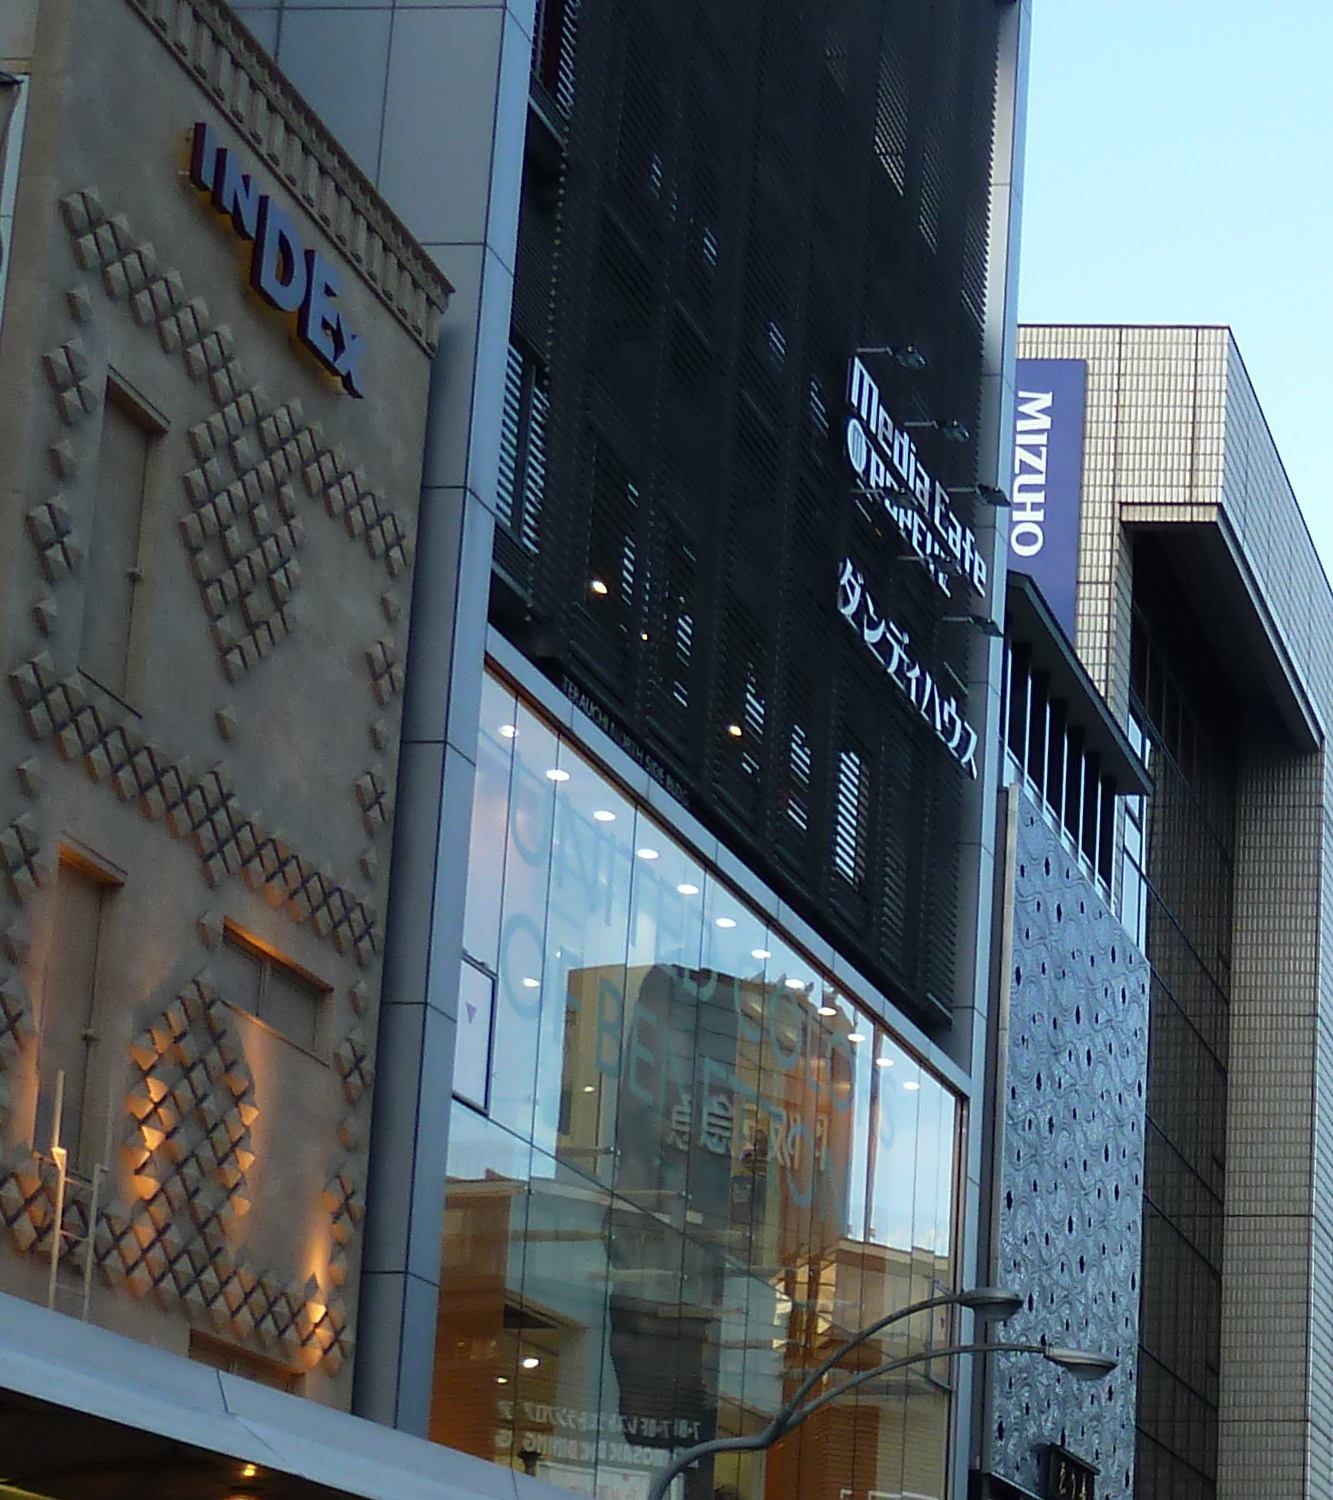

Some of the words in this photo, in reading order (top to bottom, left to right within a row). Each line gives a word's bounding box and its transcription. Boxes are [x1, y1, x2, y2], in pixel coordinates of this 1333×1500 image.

[187, 121, 369, 399] INDEX
[848, 356, 931, 513] Media
[1010, 390, 1053, 558] MIZUHO
[836, 555, 979, 781] ダンディハウス
